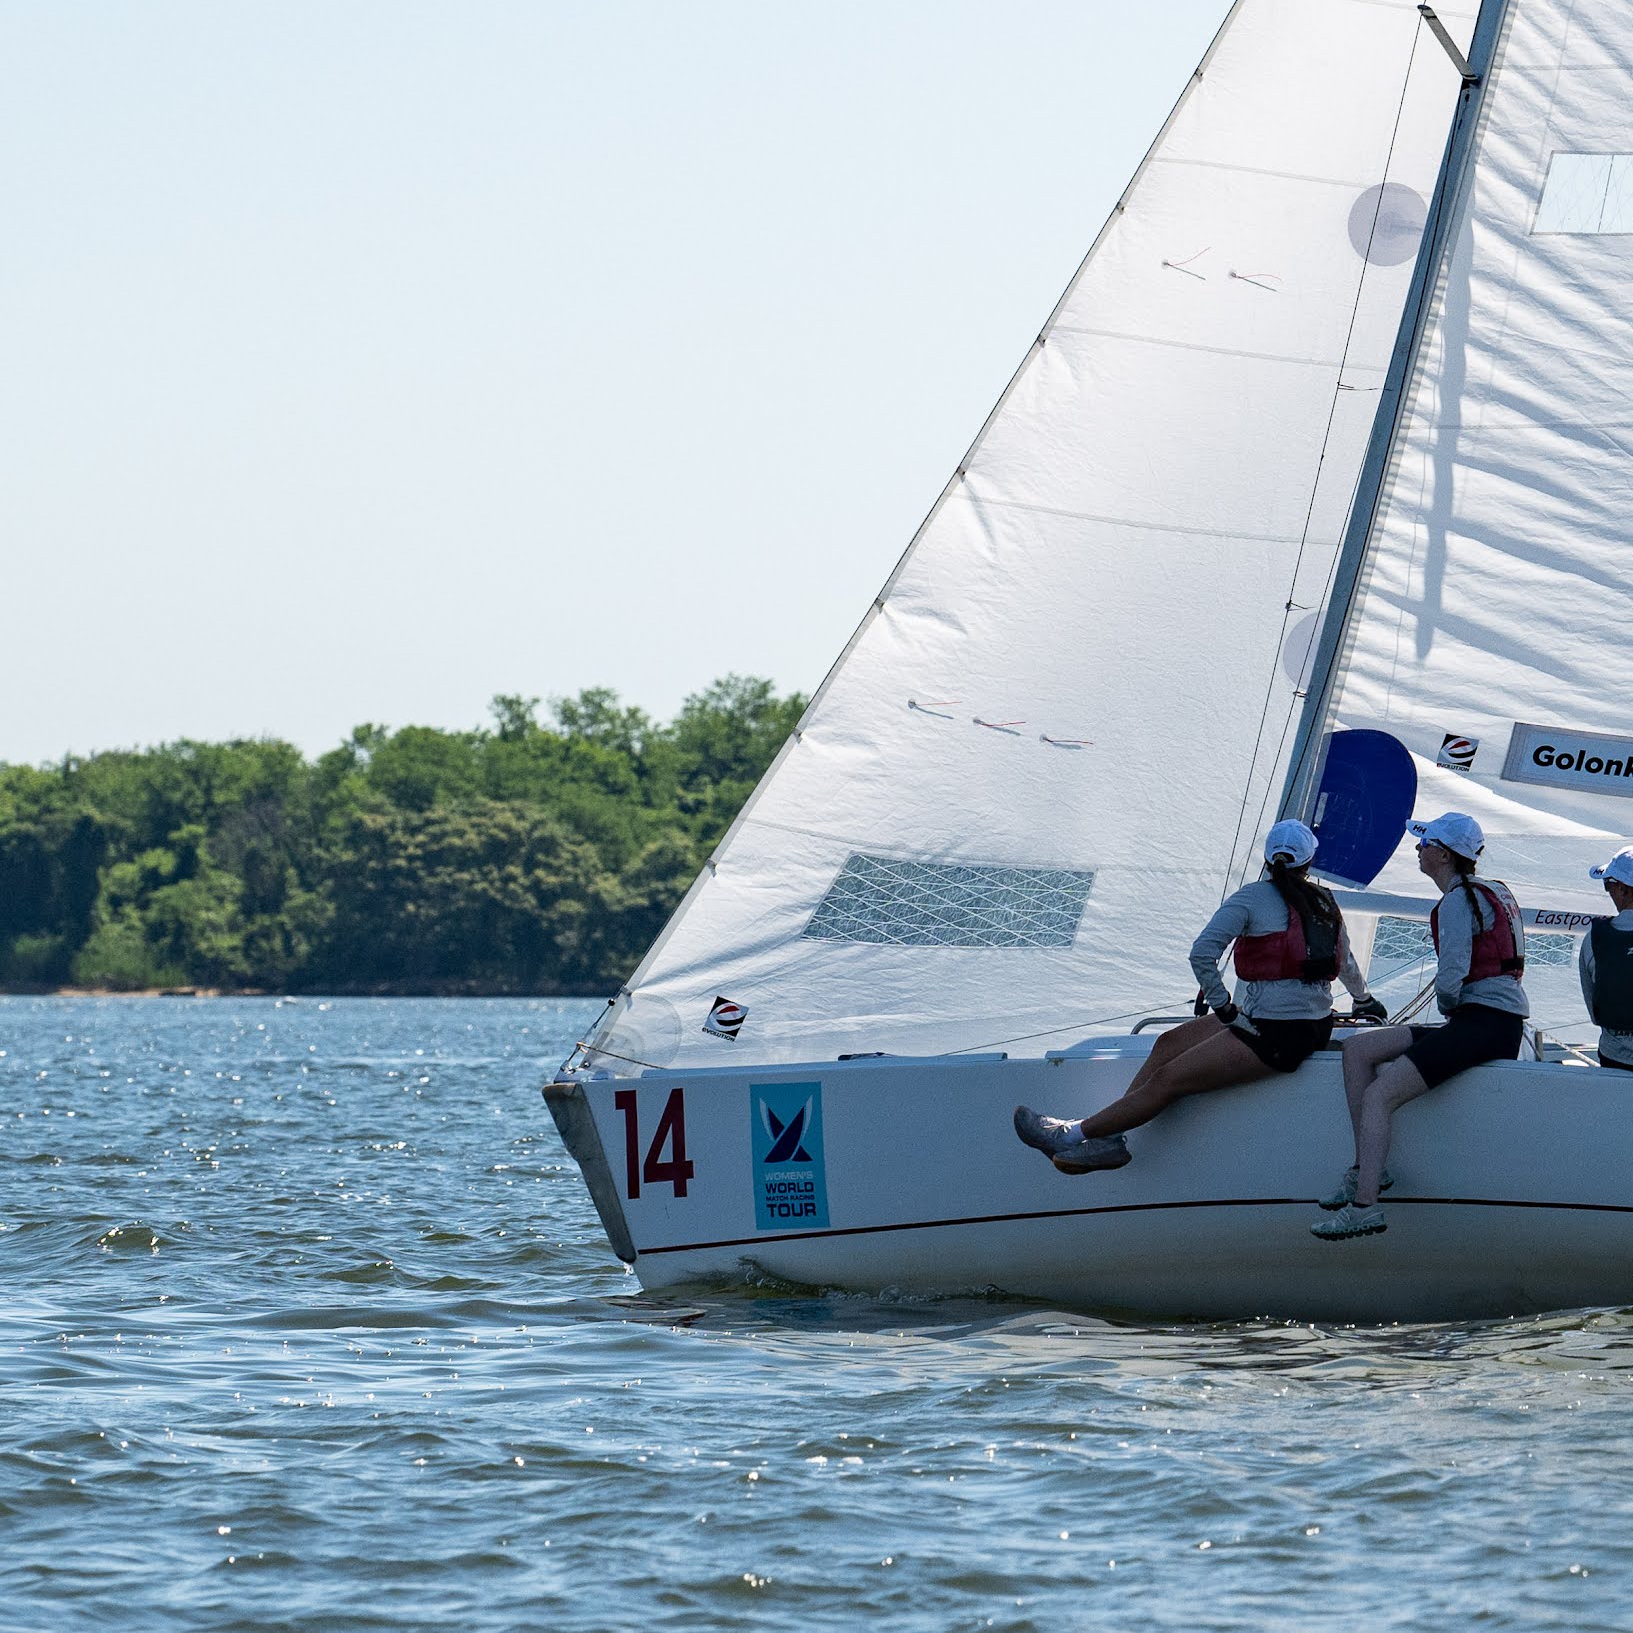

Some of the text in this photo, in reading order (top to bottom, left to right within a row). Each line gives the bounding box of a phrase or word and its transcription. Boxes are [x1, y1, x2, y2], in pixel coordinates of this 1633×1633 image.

[615, 1088, 694, 1199] 14
[765, 1171, 814, 1180] WOMEN'S
[765, 1182, 814, 1193] WORLD
[766, 1203, 816, 1217] TOUR
